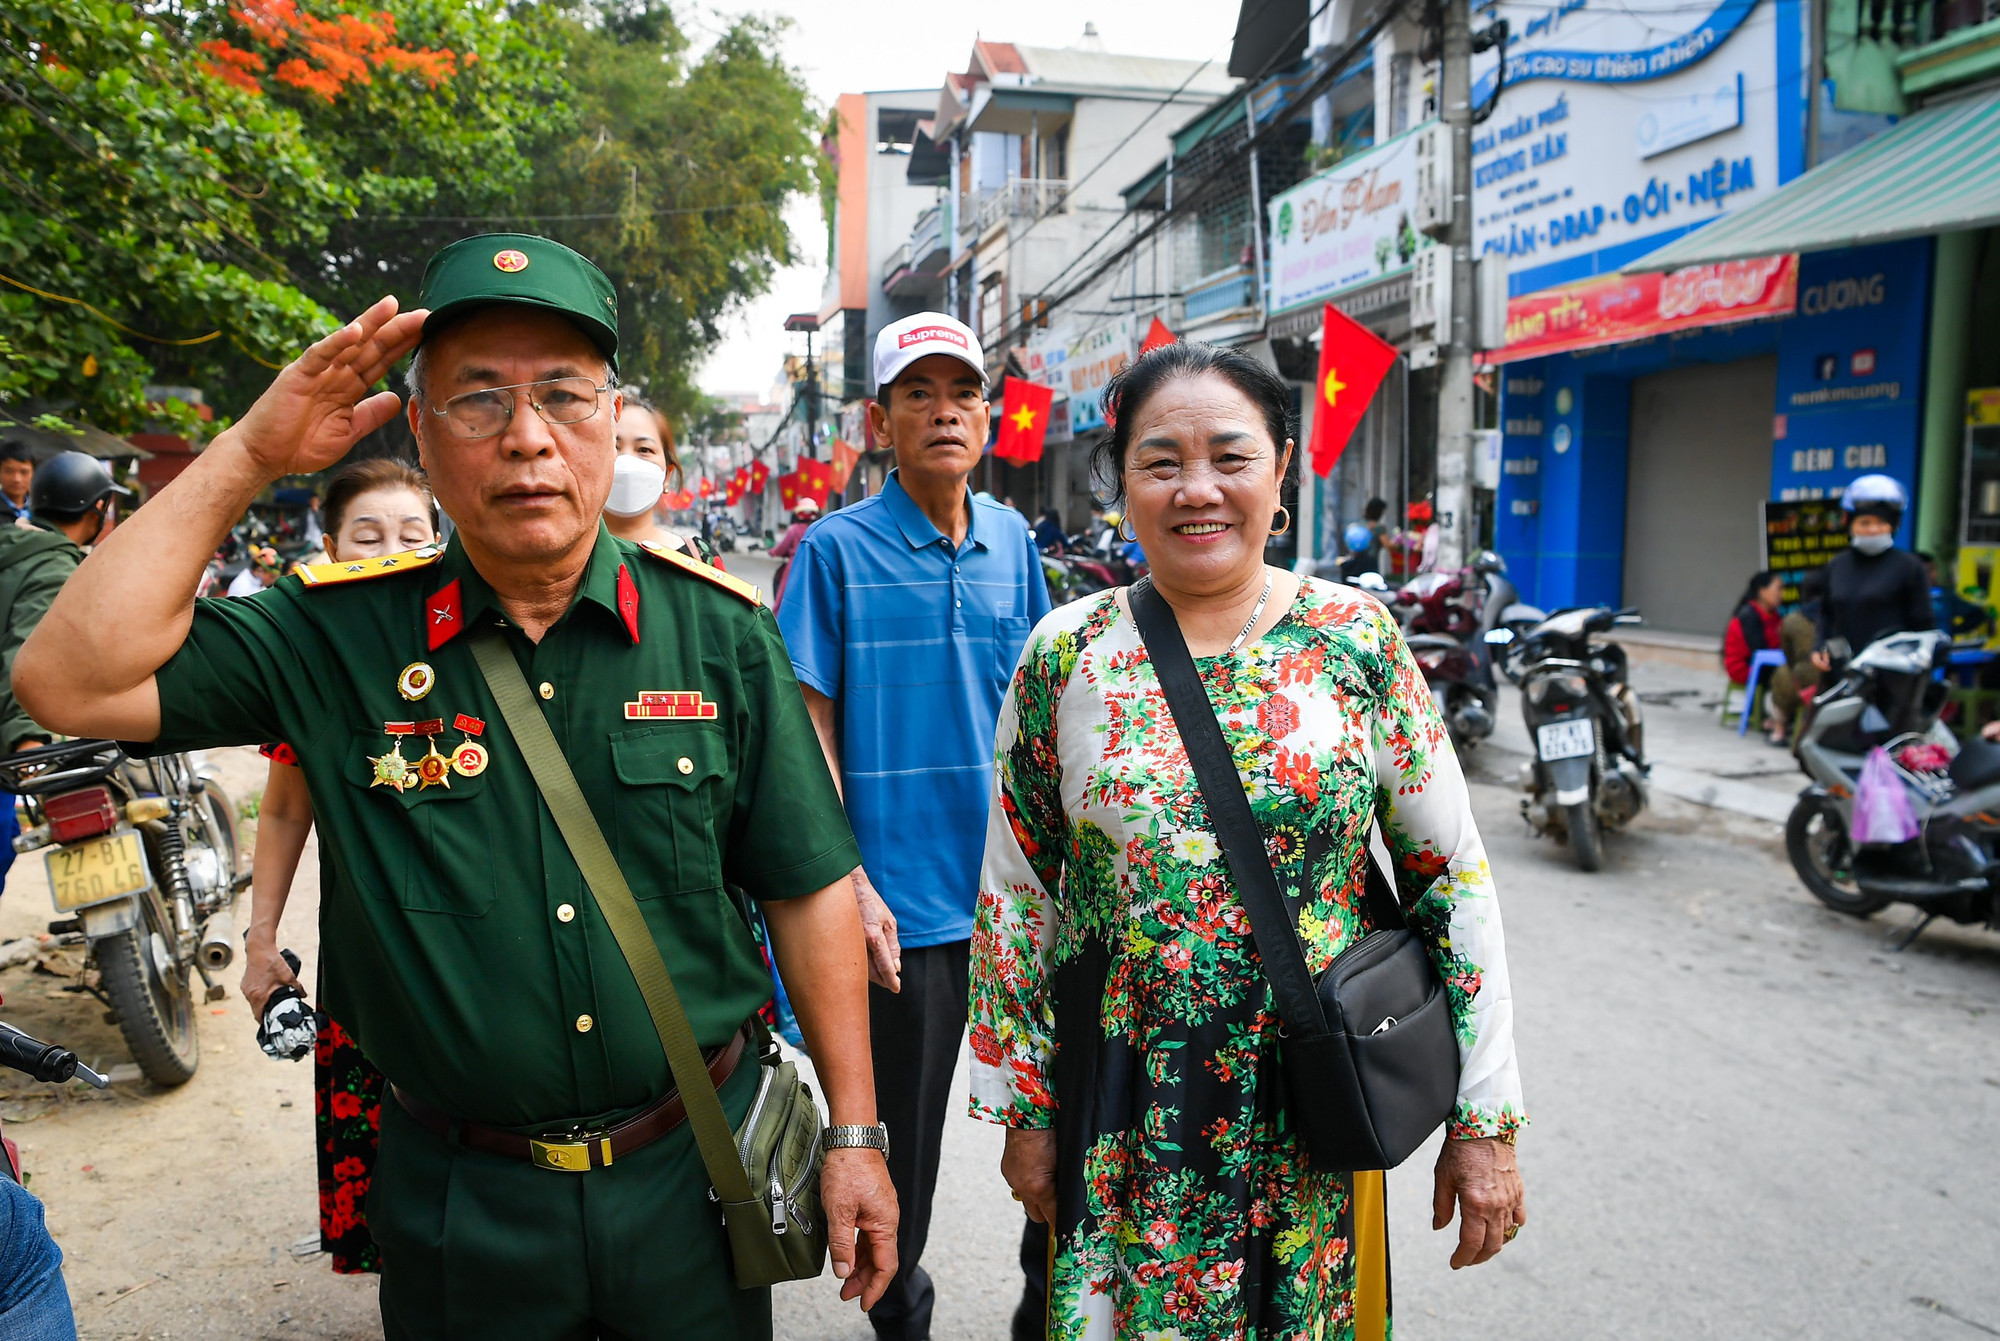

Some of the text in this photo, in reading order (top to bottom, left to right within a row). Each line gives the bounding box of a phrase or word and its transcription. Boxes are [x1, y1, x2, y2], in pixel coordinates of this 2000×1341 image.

[1532, 53, 1566, 75] cao
[1595, 55, 1647, 78] thiên
[1650, 27, 1715, 71] nhiên
[1549, 205, 1605, 247] DRAP
[1623, 176, 1669, 224] GỐI
[1689, 156, 1755, 209] NỆM
[902, 329, 965, 345] Supreme
[59, 837, 126, 877] 27-B1
